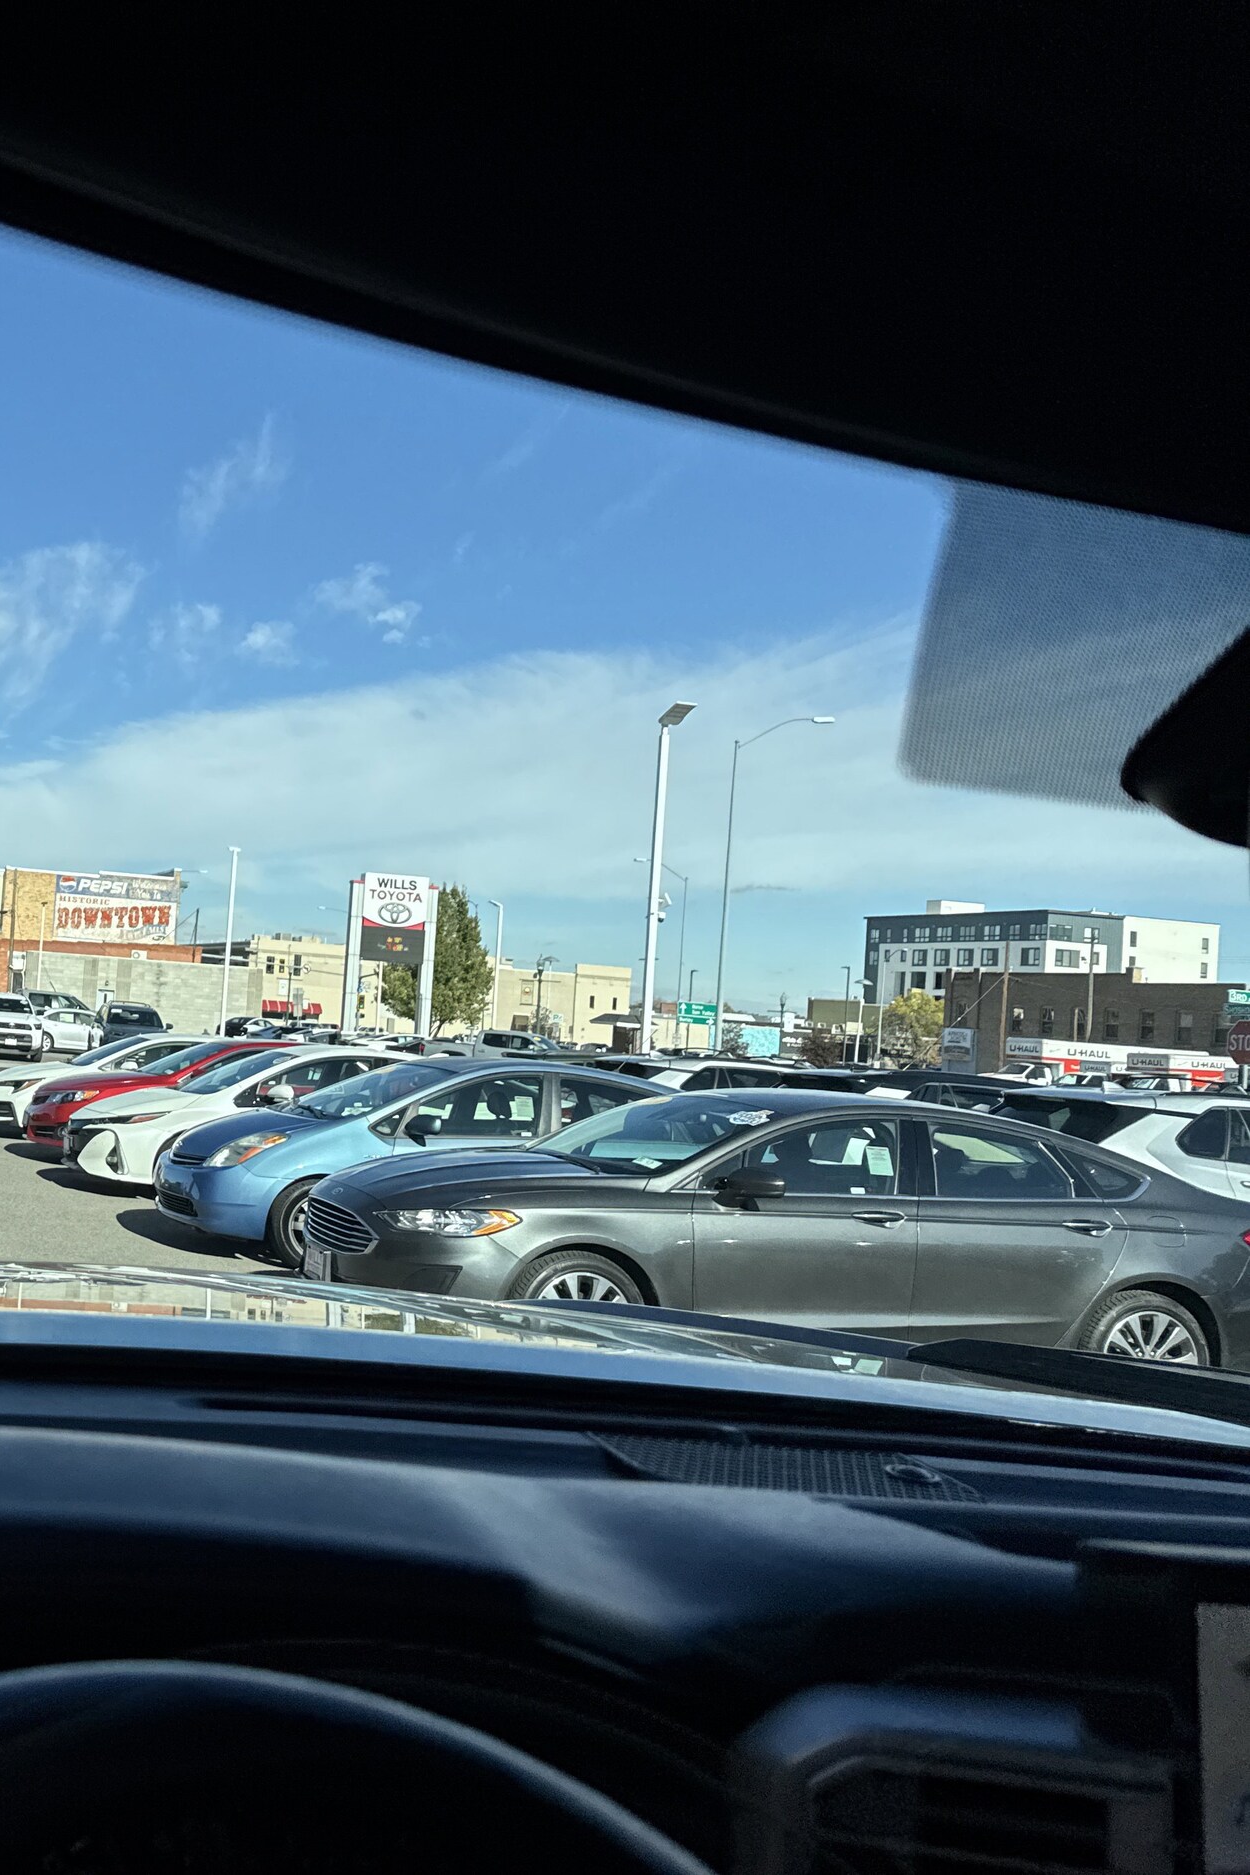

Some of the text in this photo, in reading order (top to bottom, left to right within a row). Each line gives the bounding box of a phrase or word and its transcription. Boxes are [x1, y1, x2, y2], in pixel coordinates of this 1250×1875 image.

[78, 878, 128, 895] PEPSI
[377, 877, 418, 891] WILLS
[58, 895, 111, 906] HISTORIC
[369, 888, 423, 903] TOYOTA
[56, 905, 172, 930] DOWNTOWN
[1230, 991, 1248, 1002] 3RD
[1009, 1044, 1040, 1054] U-HAUL
[1067, 1048, 1111, 1059] U-HAUL
[1131, 1058, 1164, 1067] U-HAUL
